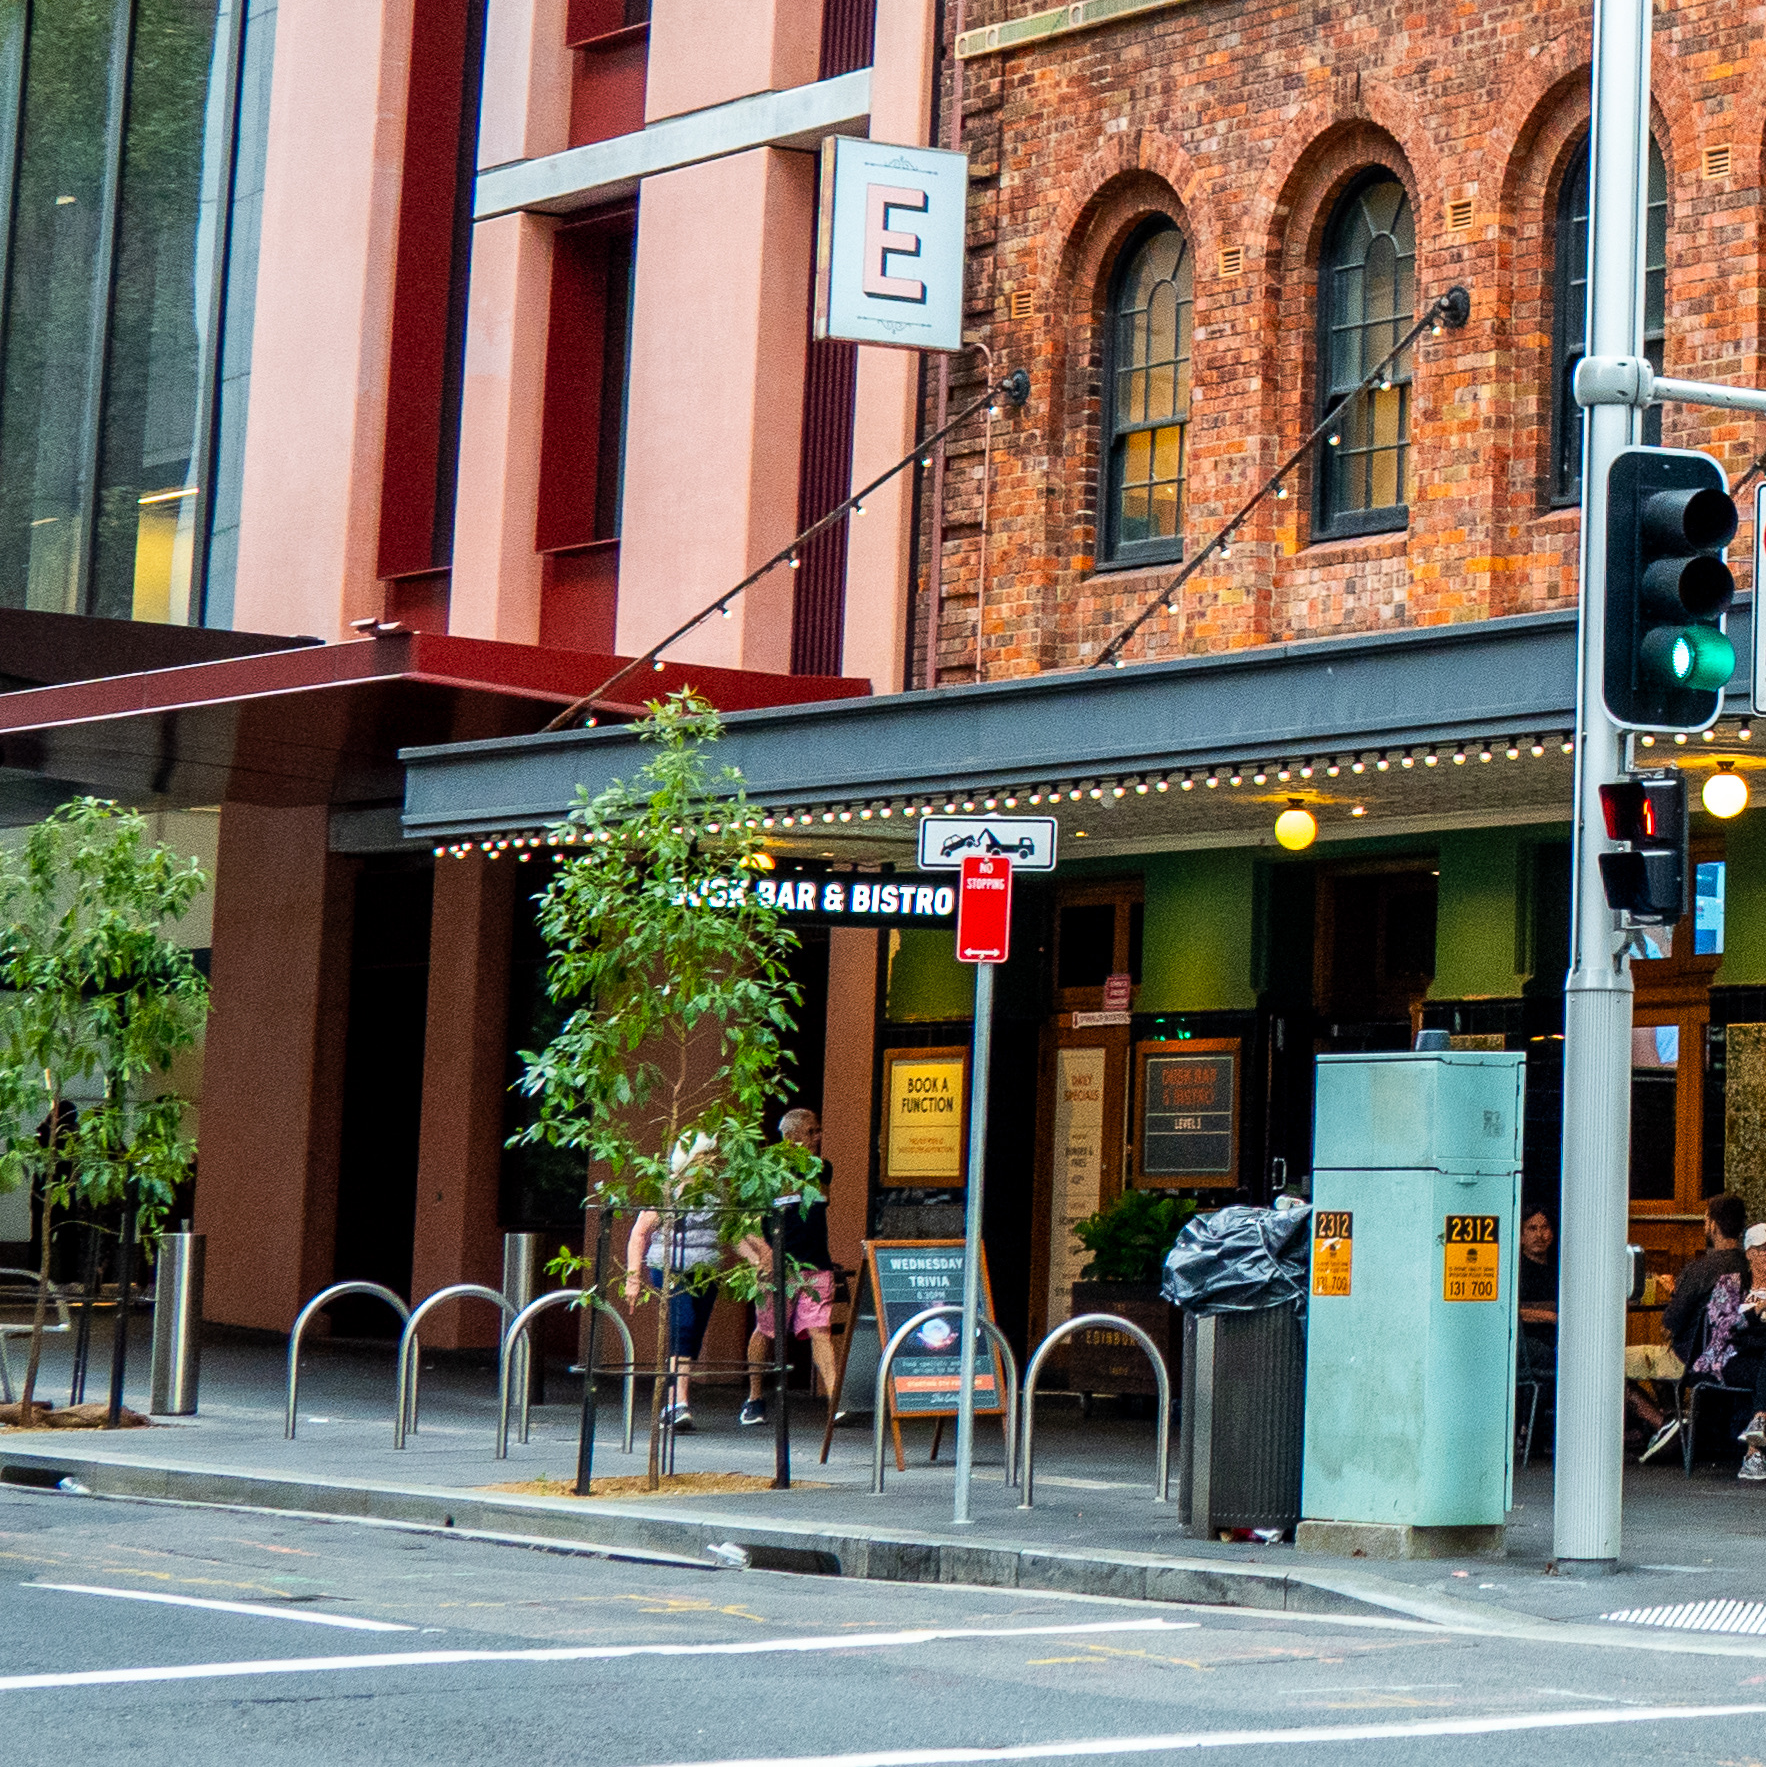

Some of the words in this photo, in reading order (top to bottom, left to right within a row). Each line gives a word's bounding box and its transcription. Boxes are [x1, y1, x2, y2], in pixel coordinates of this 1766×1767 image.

[863, 182, 928, 305] E
[979, 862, 993, 874] NO
[966, 878, 1005, 890] STOPPING
[757, 880, 816, 911] BAR
[823, 883, 845, 912] &
[851, 885, 954, 916] BISTRO
[908, 1077, 938, 1093] BOOK
[941, 1077, 949, 1093] A
[901, 1096, 954, 1113] FUNCTION
[1318, 1213, 1349, 1237] 2312
[1452, 1218, 1494, 1242] 2312
[890, 1257, 964, 1270] WEDNESDAY
[908, 1276, 950, 1287] TRIVIA
[1450, 1281, 1465, 1296] 131
[1471, 1281, 1493, 1296] 700
